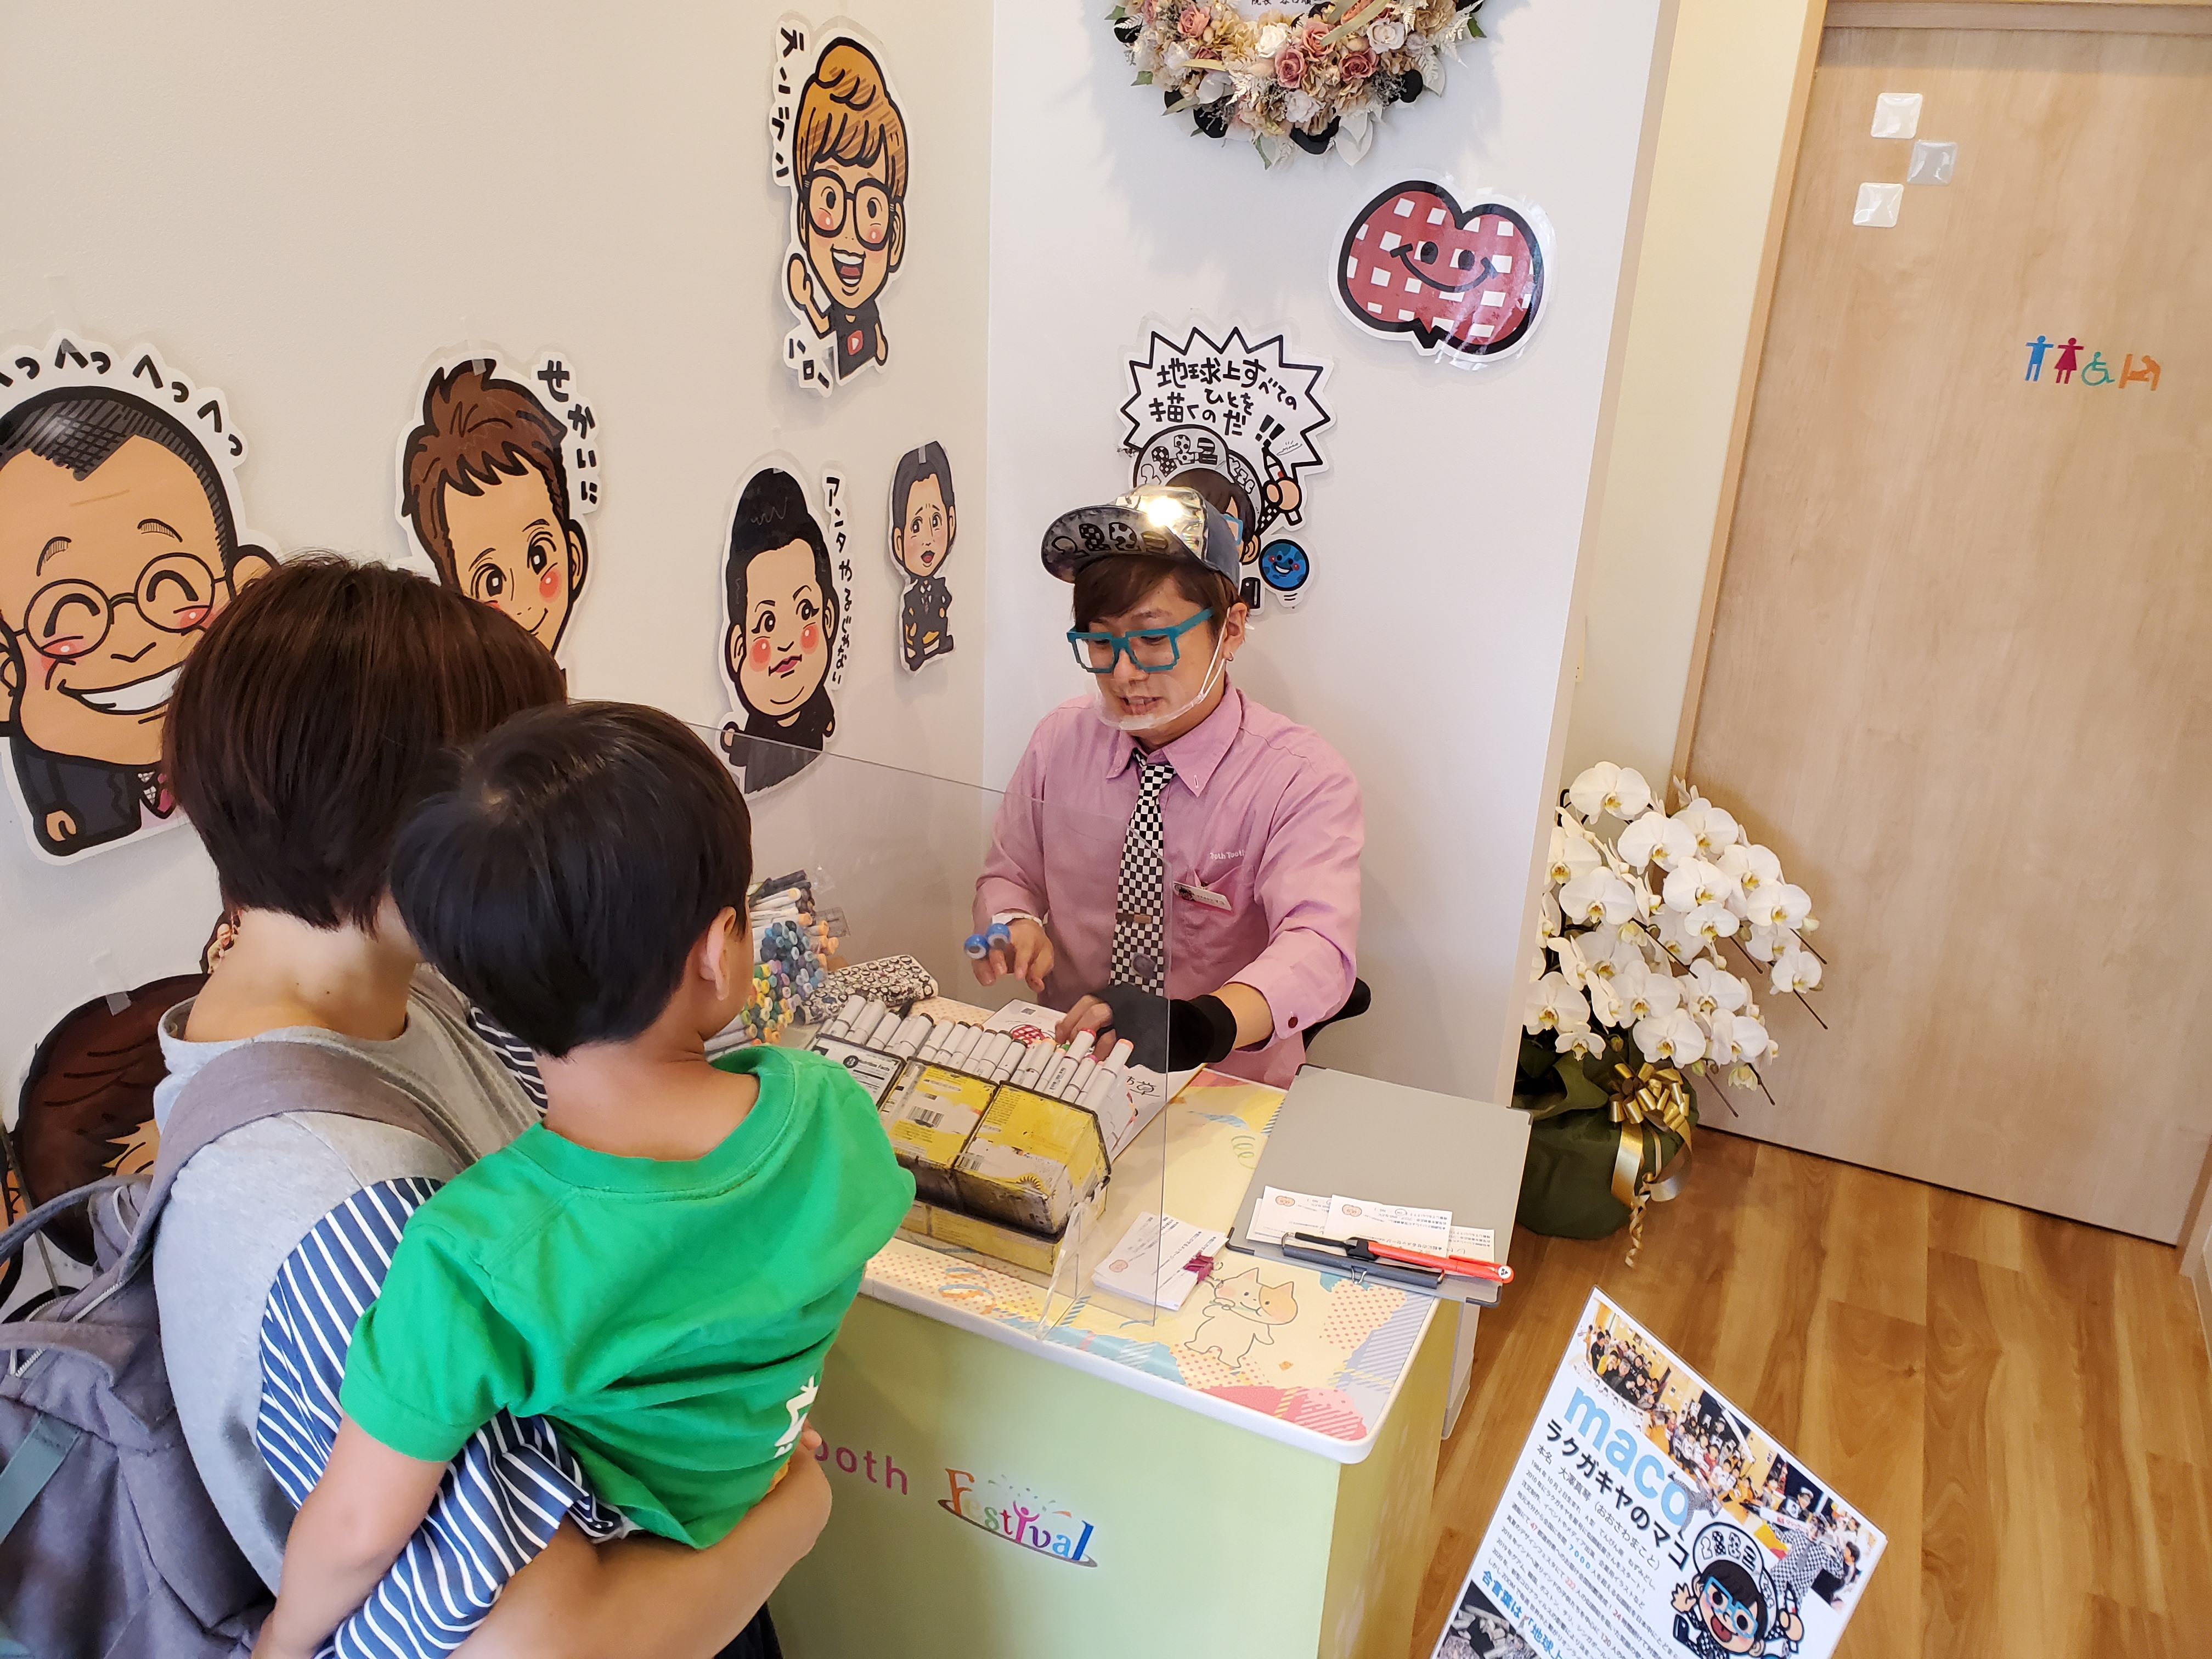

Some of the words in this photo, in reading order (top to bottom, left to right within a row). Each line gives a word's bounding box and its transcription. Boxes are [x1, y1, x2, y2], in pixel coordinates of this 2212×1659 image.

[0, 338, 242, 456] っへっへっへっ
[537, 360, 597, 504] せかいに
[1156, 357, 1297, 410] 地球上すべての
[1204, 388, 1254, 415] ひとを
[1536, 1442, 1554, 1465] 本名
[1543, 1417, 1690, 1572] ラクガキヤのマコ
[1565, 1386, 1689, 1527] maco
